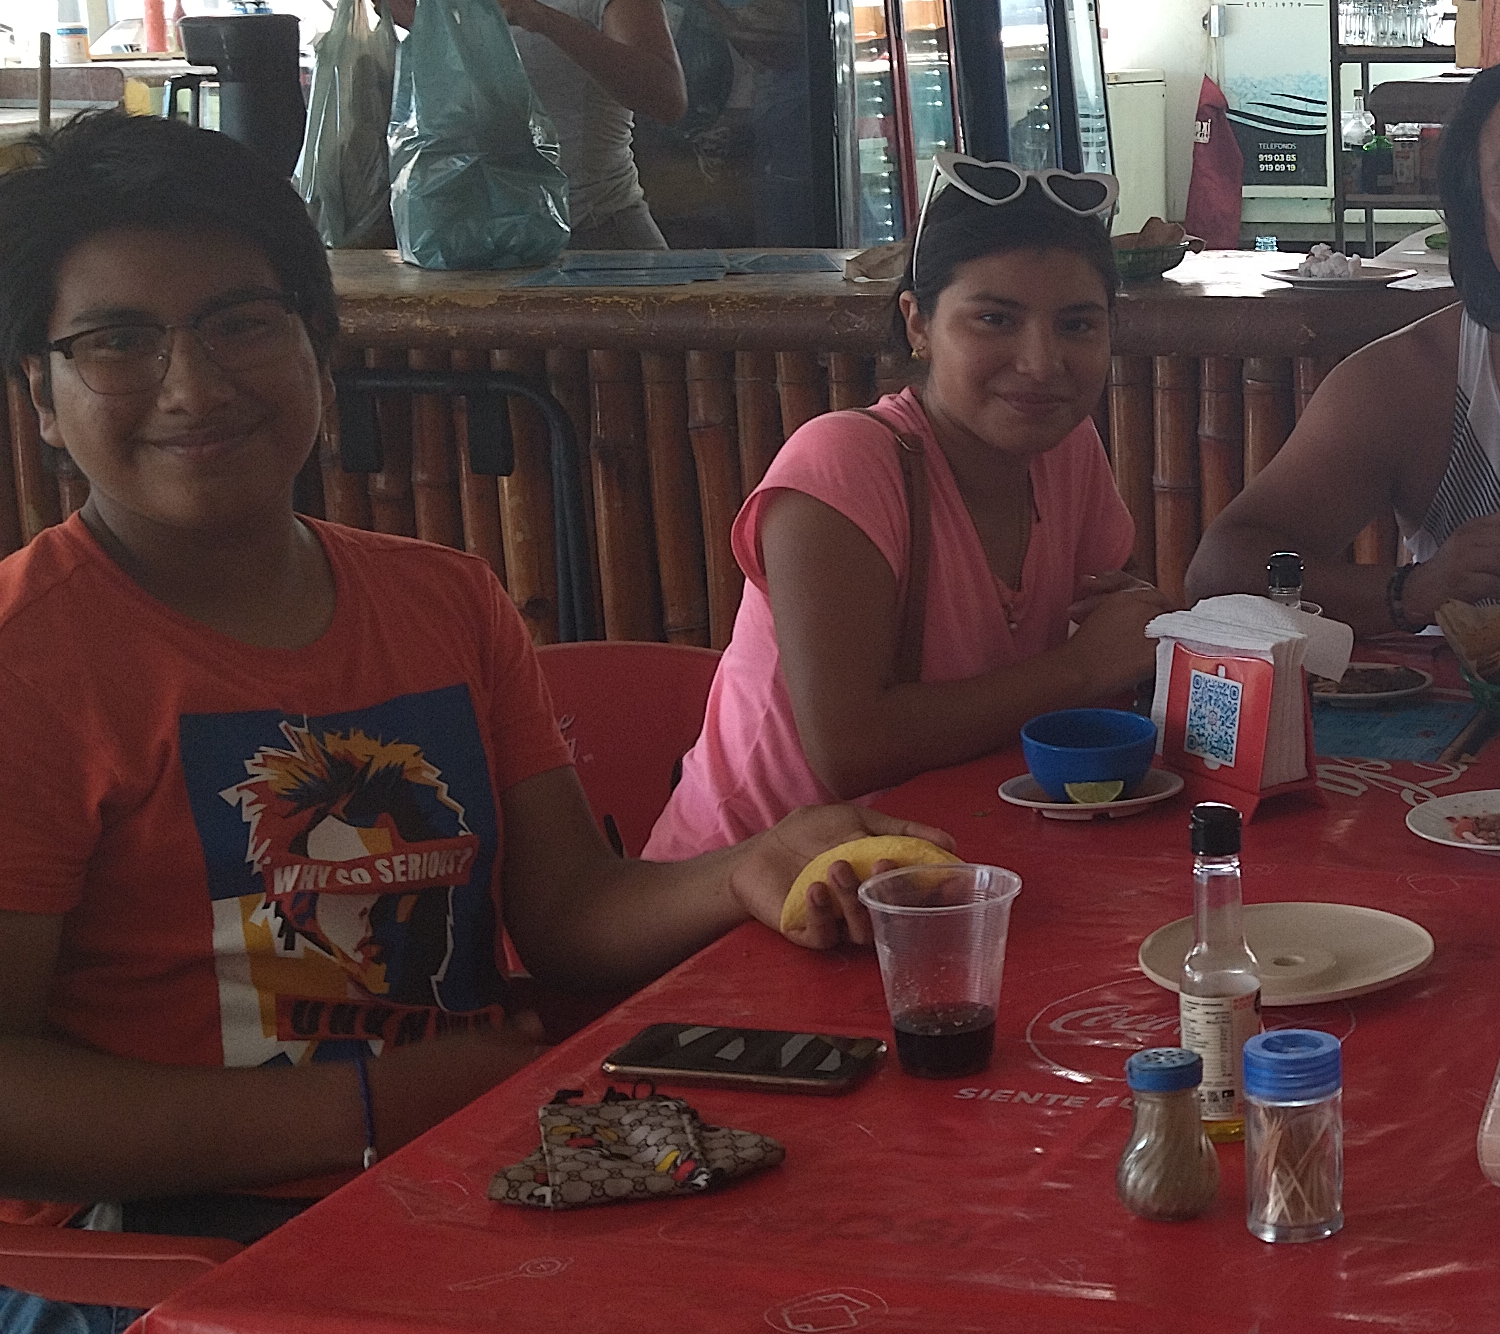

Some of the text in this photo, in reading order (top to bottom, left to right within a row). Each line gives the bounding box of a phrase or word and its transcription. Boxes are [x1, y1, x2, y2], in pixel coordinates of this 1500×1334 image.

[1258, 153, 1273, 162] 919
[1260, 163, 1274, 172] 919
[273, 848, 474, 895] WHY SO SERIOUS?
[953, 1087, 1090, 1108] SIENTE
